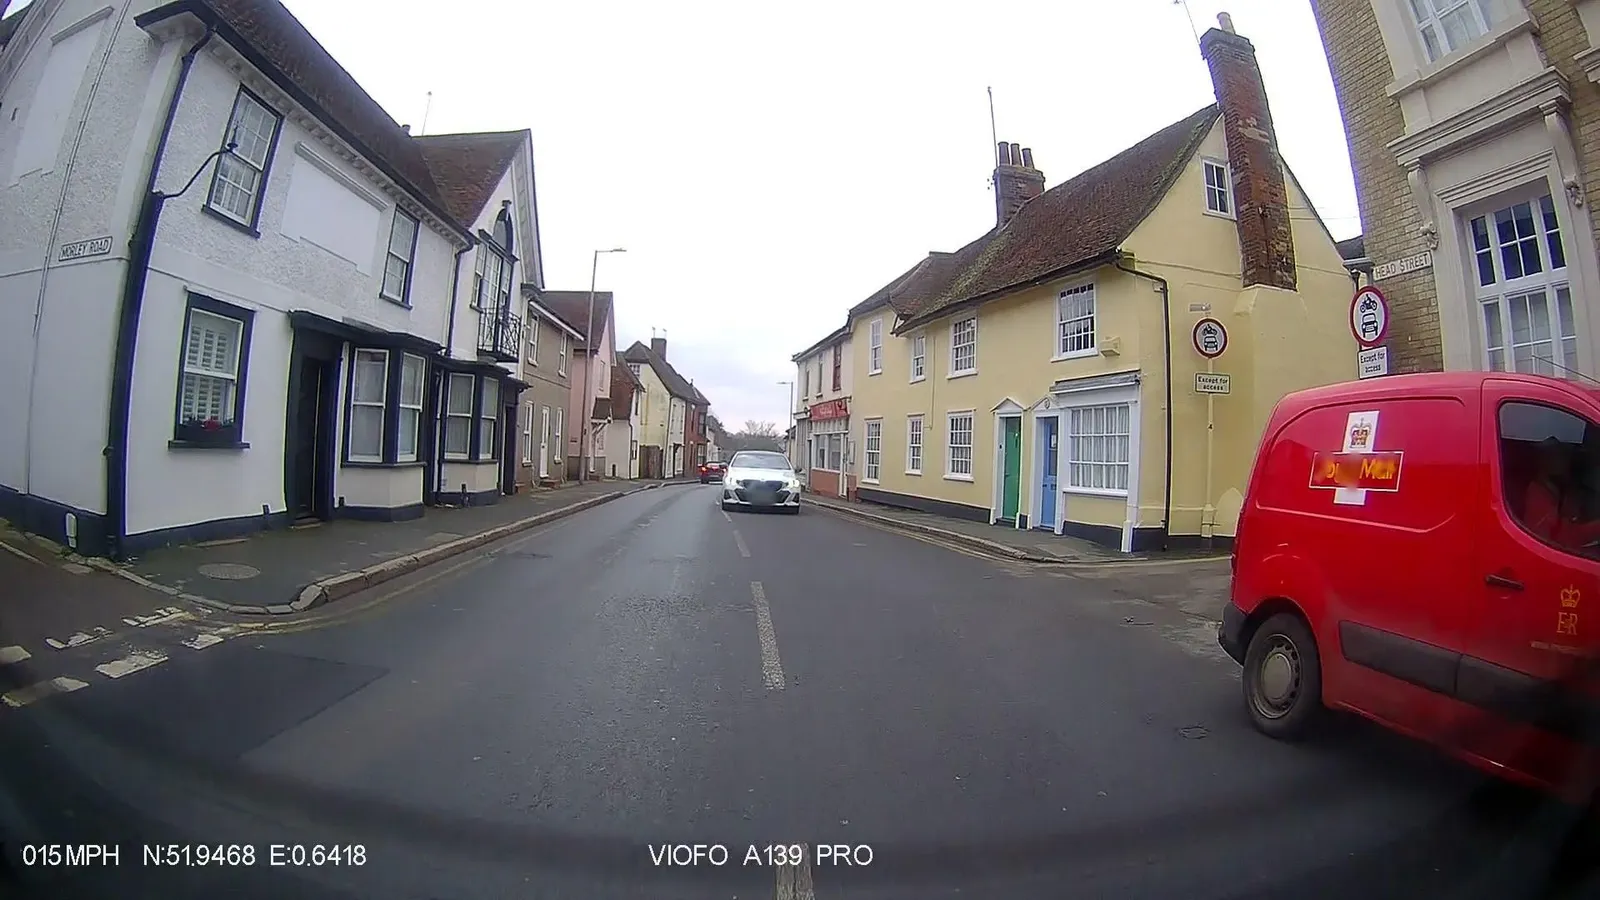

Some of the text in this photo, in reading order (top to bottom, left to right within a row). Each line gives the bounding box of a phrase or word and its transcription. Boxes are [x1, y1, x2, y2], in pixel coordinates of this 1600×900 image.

[61, 239, 109, 258] MORLEY ROAD
[1374, 252, 1428, 279] HEAD STREET
[1360, 351, 1386, 363] Except for
[1198, 375, 1219, 384] Except
